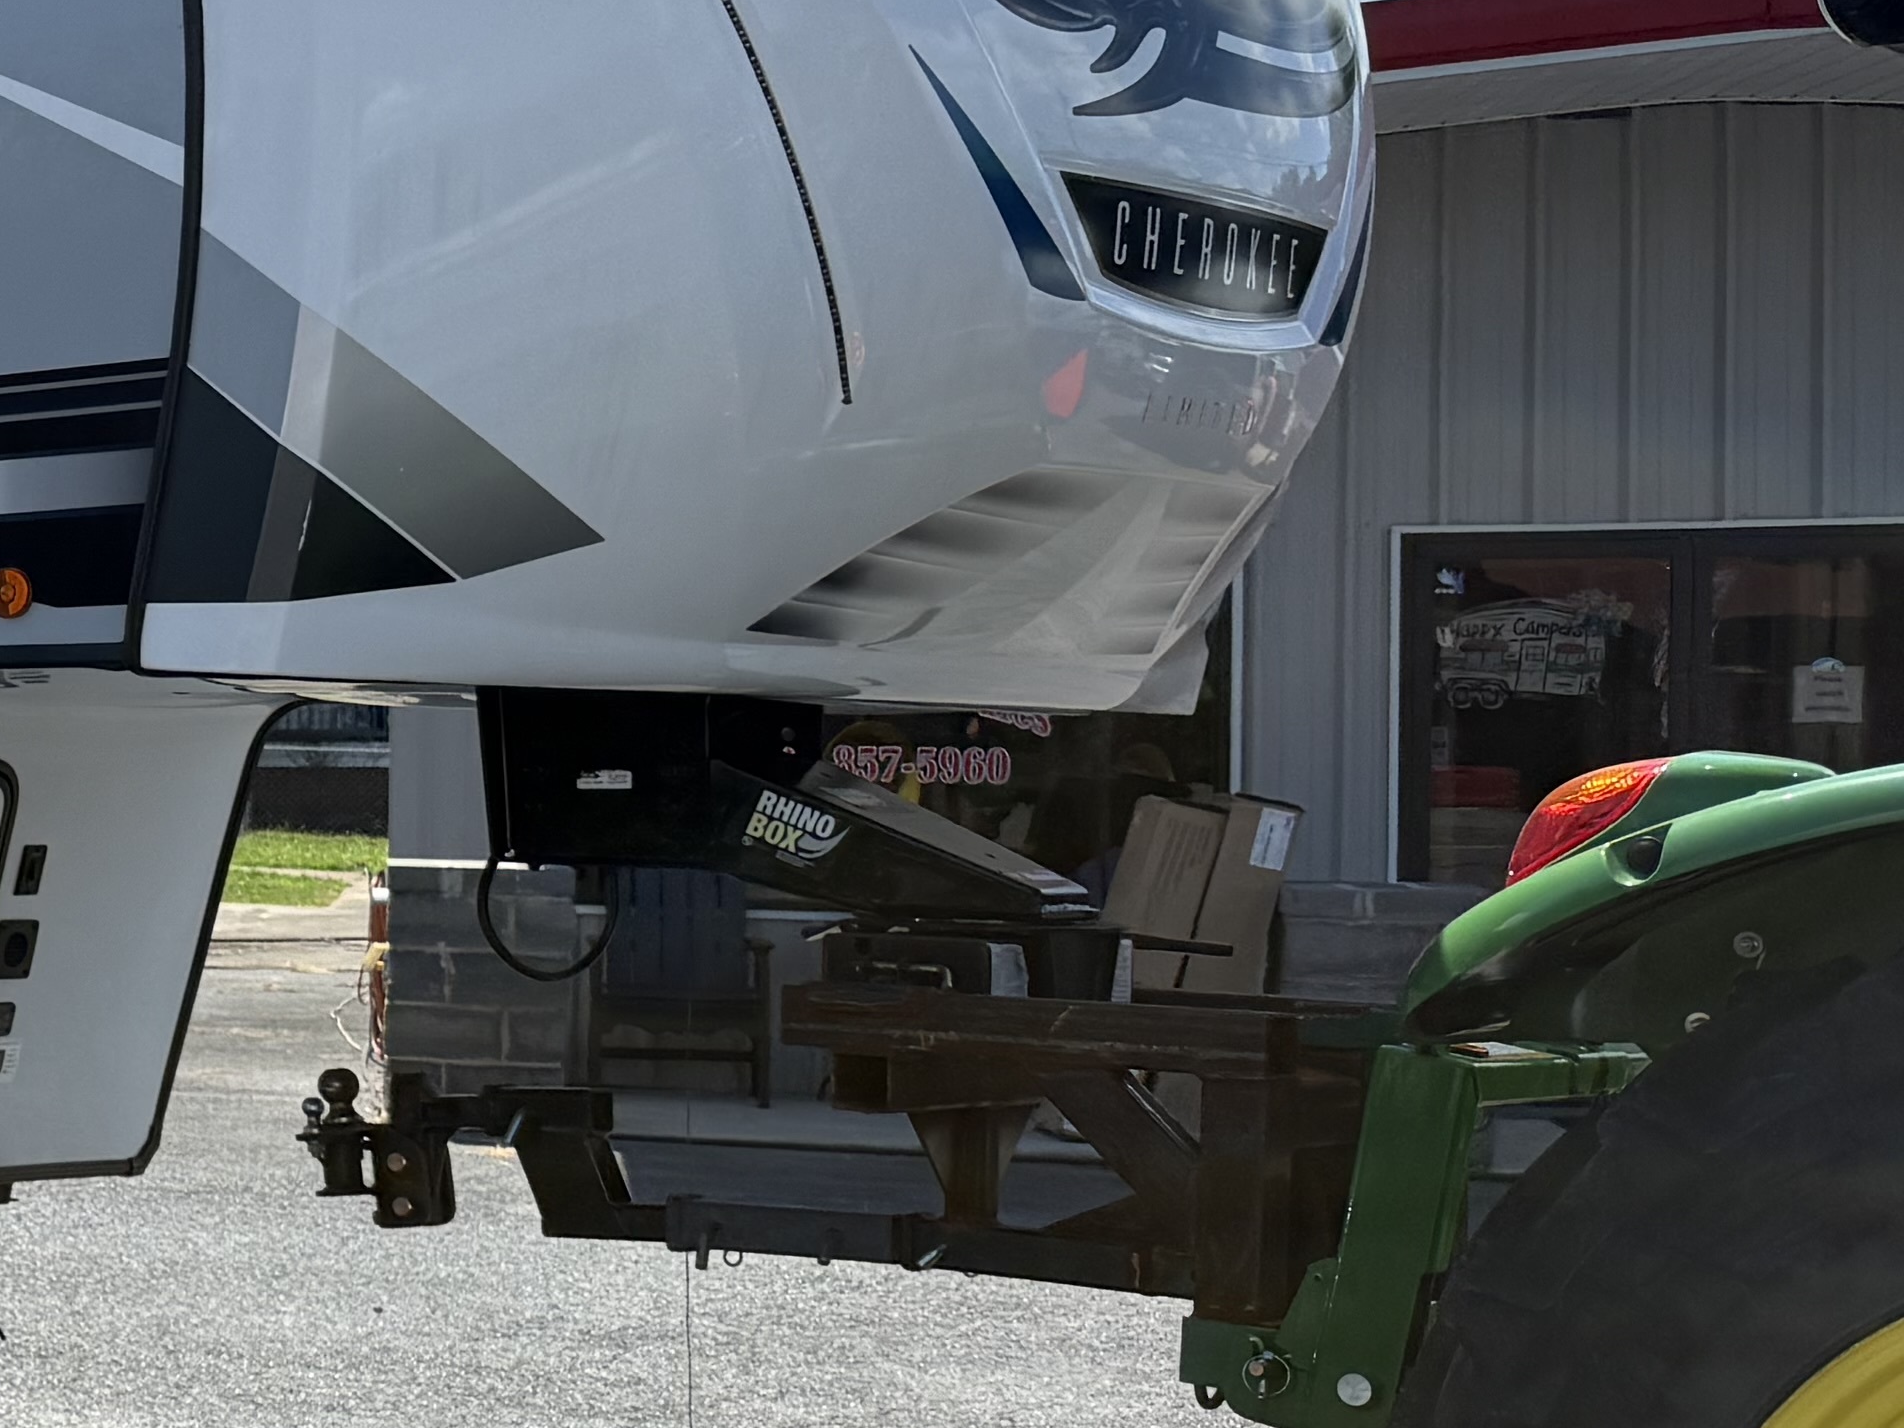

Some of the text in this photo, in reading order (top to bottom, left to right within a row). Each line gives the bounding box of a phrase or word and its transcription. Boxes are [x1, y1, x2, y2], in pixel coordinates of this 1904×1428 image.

[1113, 200, 1299, 300] CHEROKEE
[745, 811, 804, 854] BOX
[754, 789, 837, 839] RHINO
